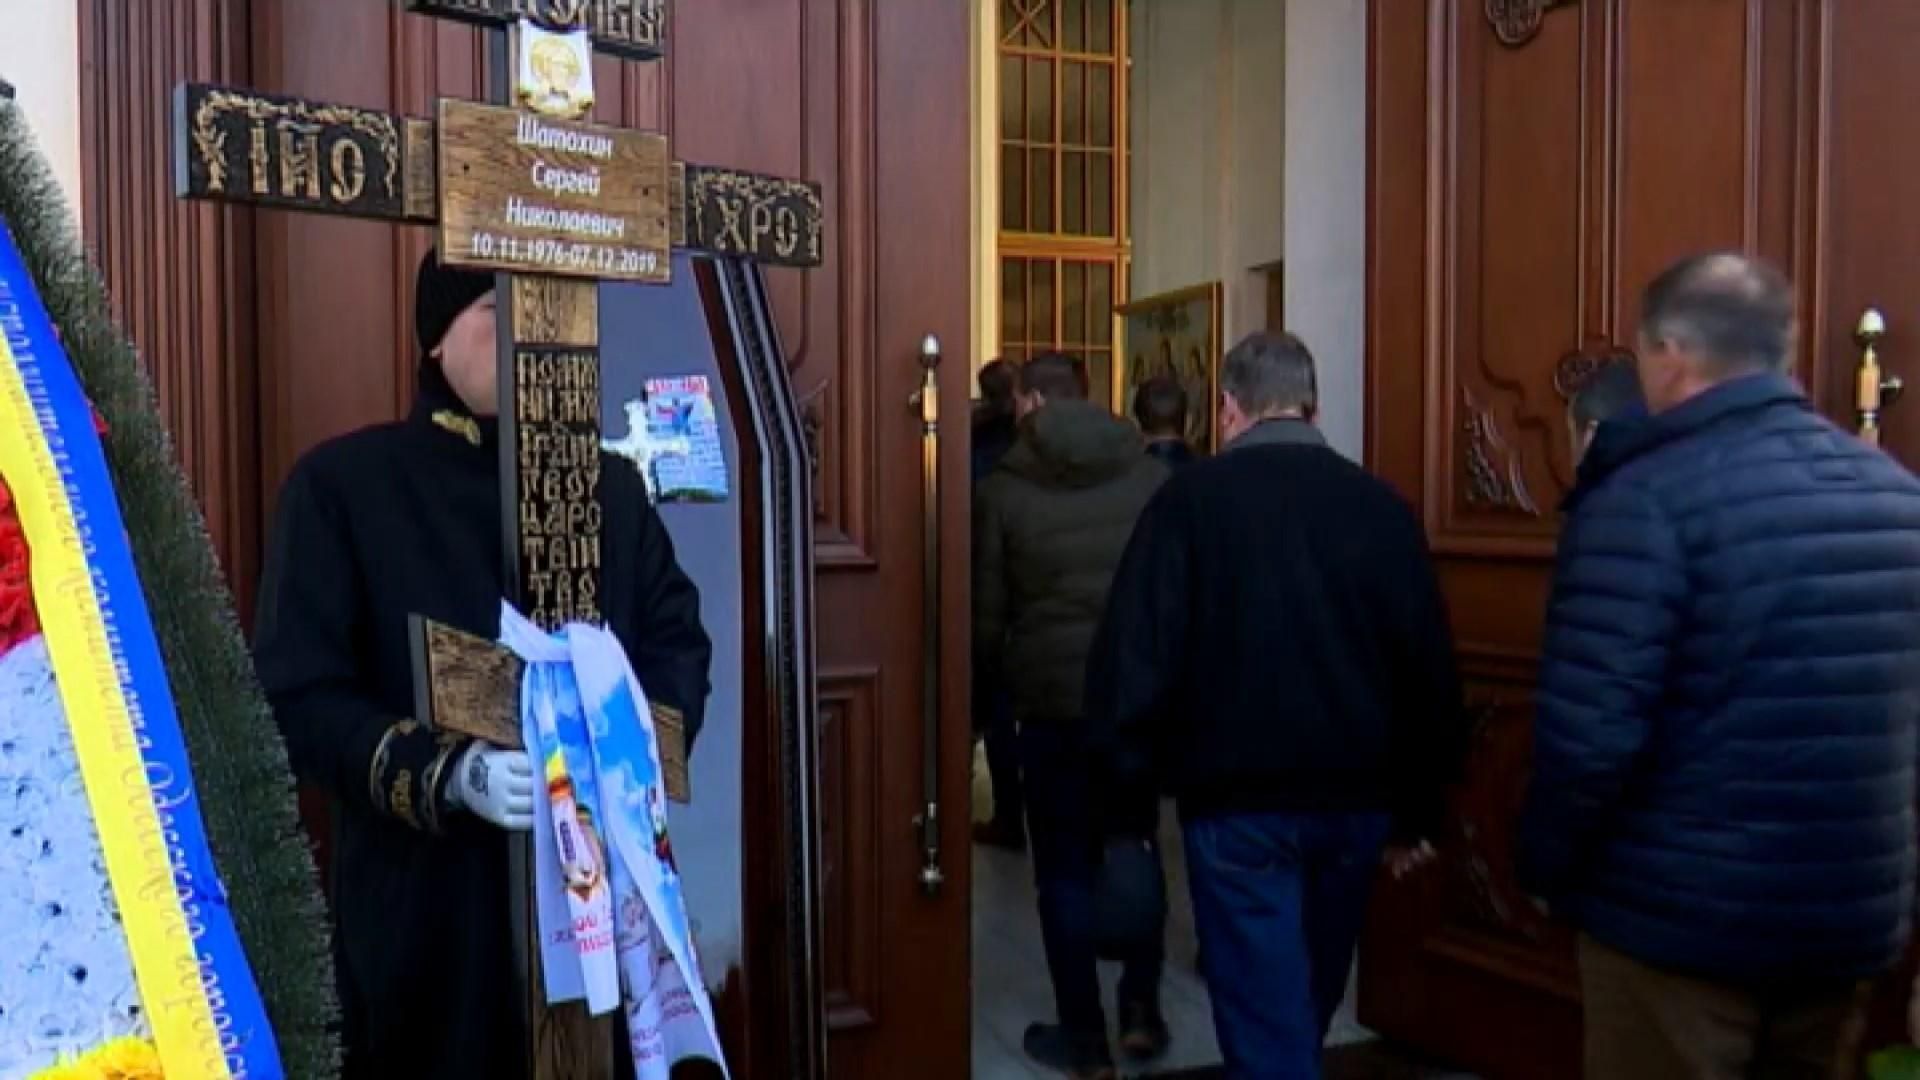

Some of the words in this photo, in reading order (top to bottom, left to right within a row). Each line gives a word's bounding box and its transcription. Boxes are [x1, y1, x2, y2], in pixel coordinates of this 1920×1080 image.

[516, 111, 614, 160] Шатохин
[532, 160, 600, 197] Сергей
[506, 195, 625, 238] Николаевич
